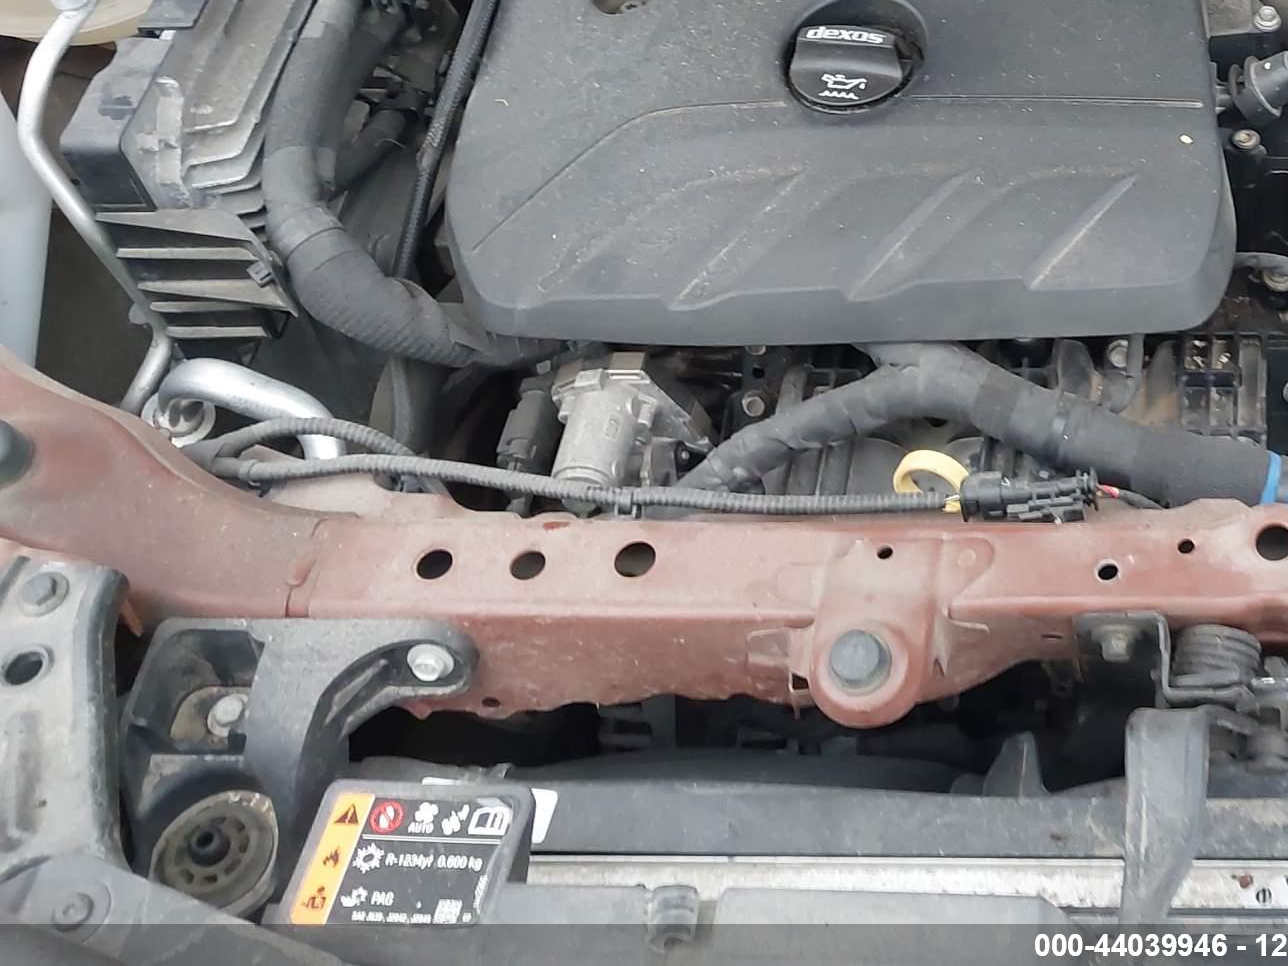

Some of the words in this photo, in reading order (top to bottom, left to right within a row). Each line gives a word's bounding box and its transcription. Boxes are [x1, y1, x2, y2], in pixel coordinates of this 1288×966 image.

[806, 25, 886, 45] dexos
[408, 822, 433, 834] AUTO
[371, 891, 395, 907] PAG
